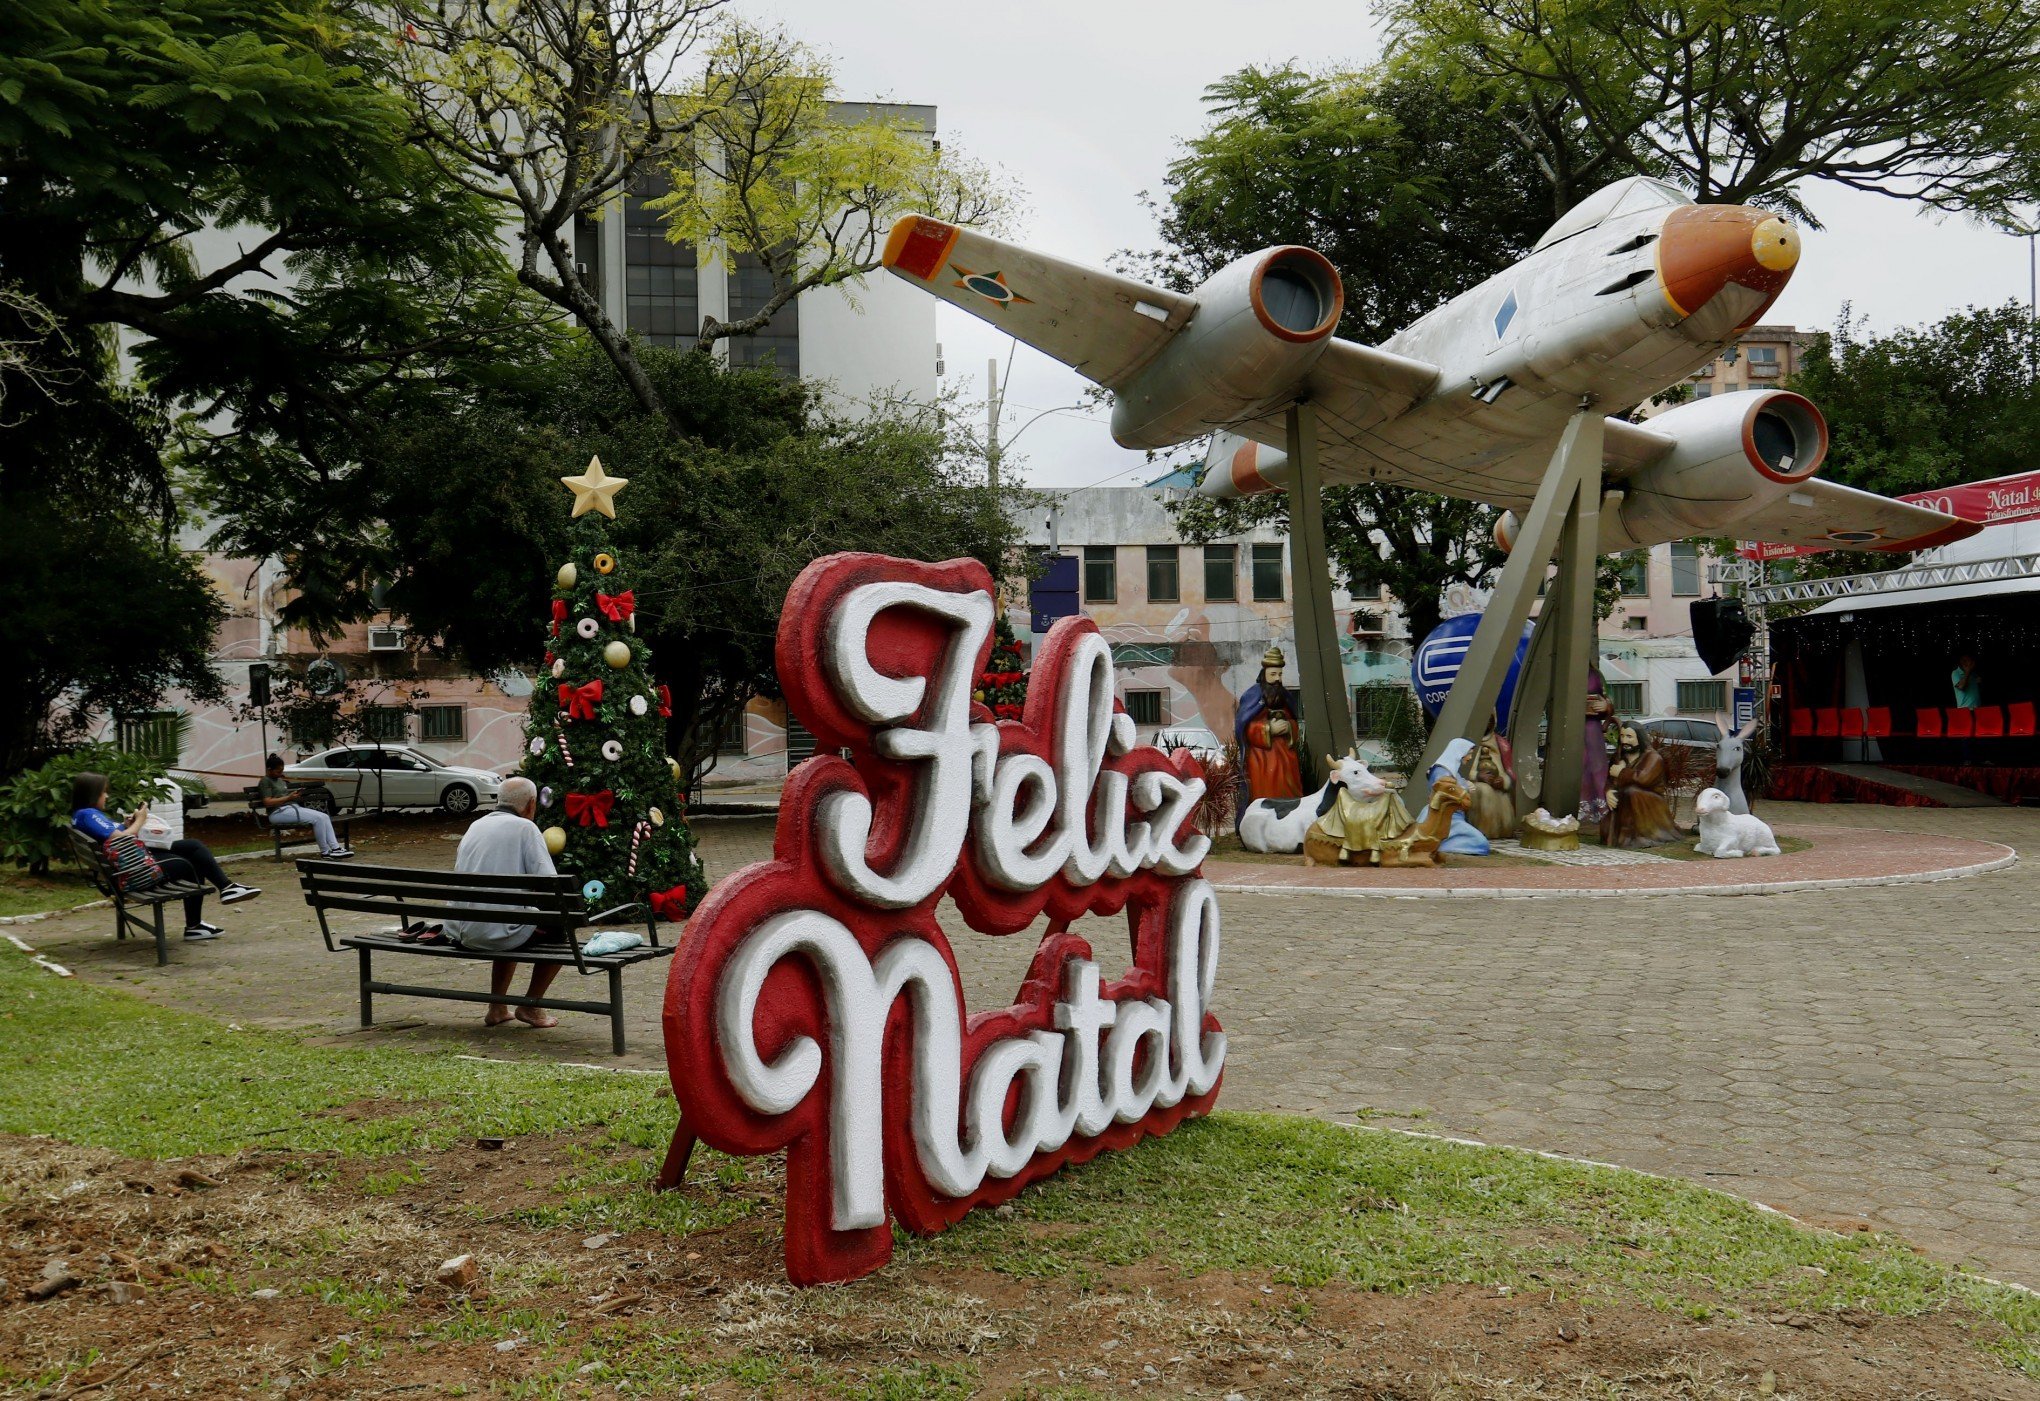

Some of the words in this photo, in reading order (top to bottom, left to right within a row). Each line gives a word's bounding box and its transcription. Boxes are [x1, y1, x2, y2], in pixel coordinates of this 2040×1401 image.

[1987, 486, 2029, 509] Natal
[815, 581, 1211, 910] Feliz
[716, 879, 1227, 1231] Natal
